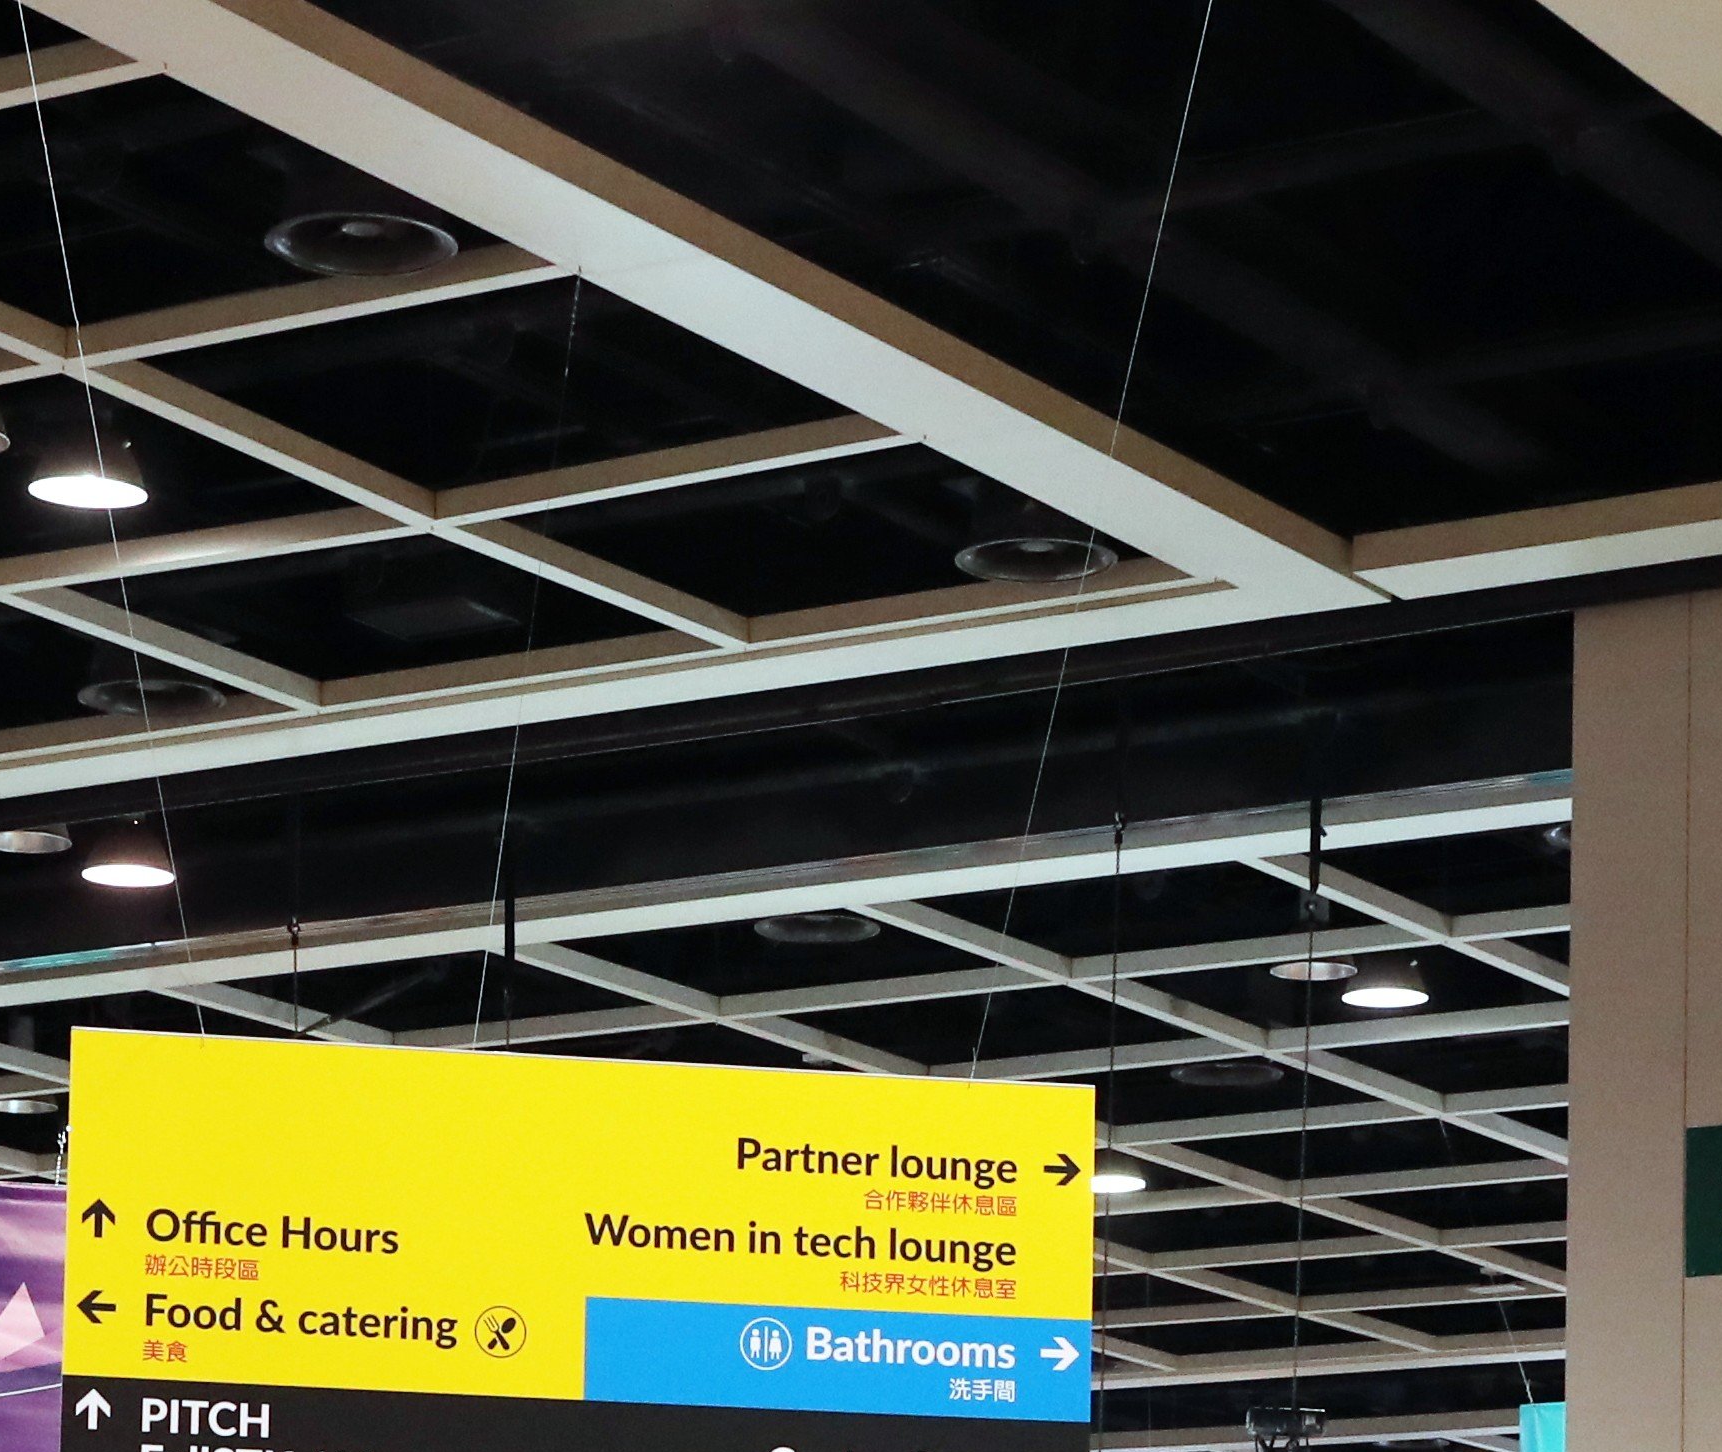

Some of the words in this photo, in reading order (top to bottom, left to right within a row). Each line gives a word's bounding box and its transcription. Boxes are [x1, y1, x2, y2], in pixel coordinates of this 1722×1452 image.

[737, 1137, 879, 1176] Partner
[891, 1144, 1017, 1189] lounge
[864, 1189, 1017, 1216] 合作夥伴休息區
[146, 1208, 267, 1247] Office
[282, 1215, 398, 1254] Hours
[584, 1212, 734, 1252] Women
[748, 1220, 780, 1254] in
[793, 1225, 875, 1259] tech
[889, 1227, 1016, 1272] lounge
[144, 1253, 259, 1280] 辦公時段區
[839, 1270, 1016, 1299] 科技界女性休息室
[145, 1293, 241, 1331] Food
[255, 1299, 285, 1333] &
[298, 1306, 458, 1349] catering
[142, 1339, 187, 1362] 美食
[806, 1326, 1015, 1368] Bathrooms
[949, 1377, 1015, 1402] 洗手間
[141, 1397, 269, 1438] PITCH
